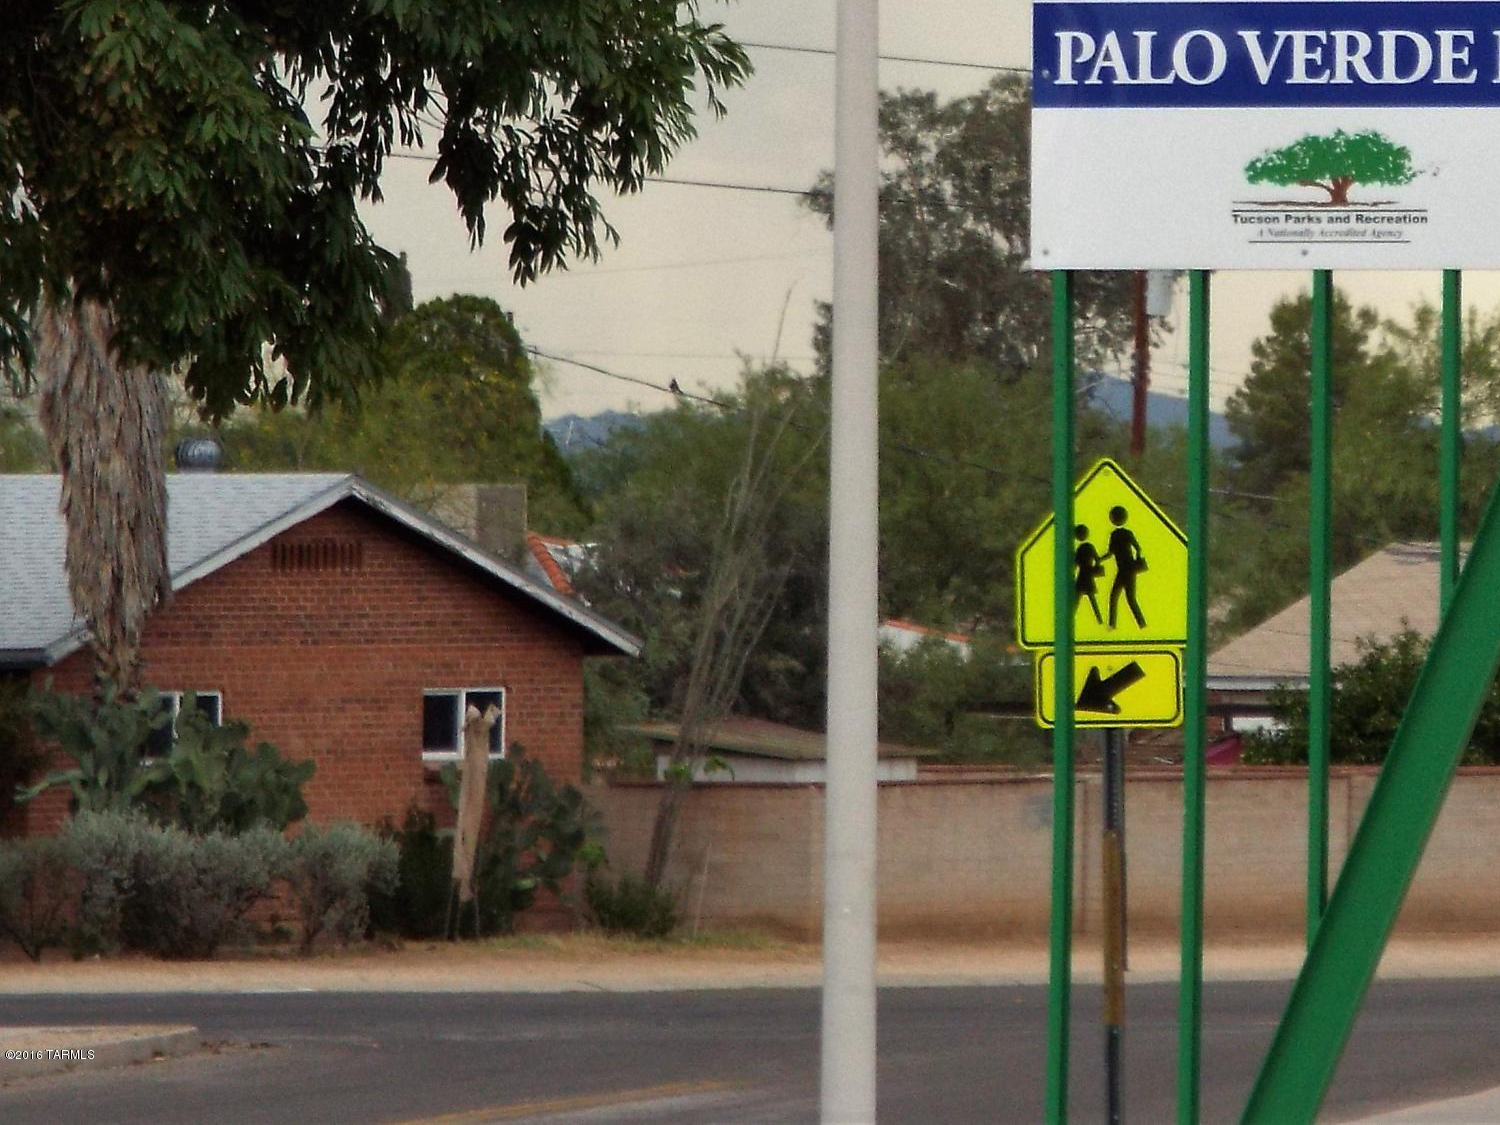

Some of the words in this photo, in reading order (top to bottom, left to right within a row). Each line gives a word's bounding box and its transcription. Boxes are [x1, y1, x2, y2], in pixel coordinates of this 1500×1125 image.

[1054, 29, 1228, 86] PALO
[1238, 29, 1478, 86] VERDE
[1232, 213, 1280, 224] Tucson
[1284, 213, 1322, 224] Parks
[1327, 213, 1350, 224] and
[1355, 213, 1428, 224] Recreation
[1268, 228, 1315, 238] Nationally
[1318, 228, 1367, 237] Accredited
[1370, 229, 1404, 239] Agency
